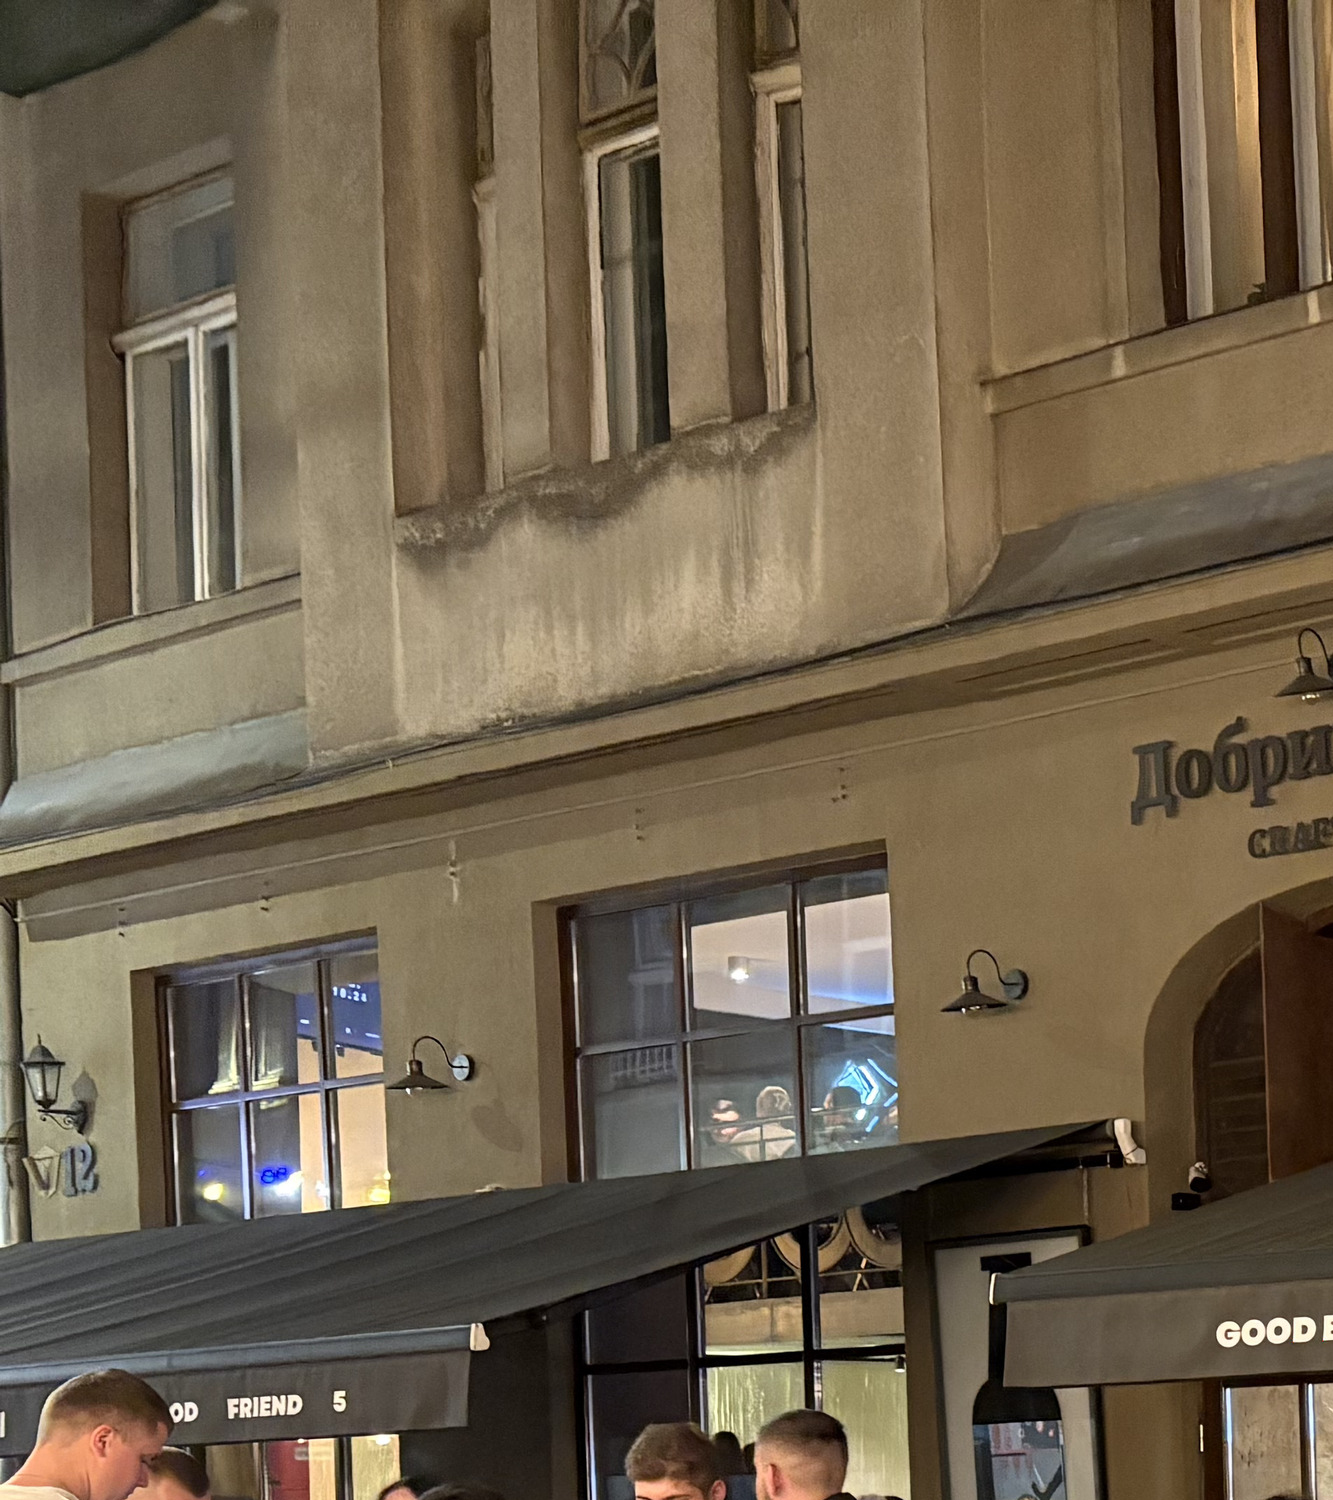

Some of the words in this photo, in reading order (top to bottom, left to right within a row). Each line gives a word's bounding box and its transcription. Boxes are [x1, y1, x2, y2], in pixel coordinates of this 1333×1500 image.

[1215, 1316, 1317, 1348] GOOD
[169, 1401, 199, 1424] OD
[226, 1394, 303, 1420] FRIEND
[332, 1390, 347, 1413] 5
